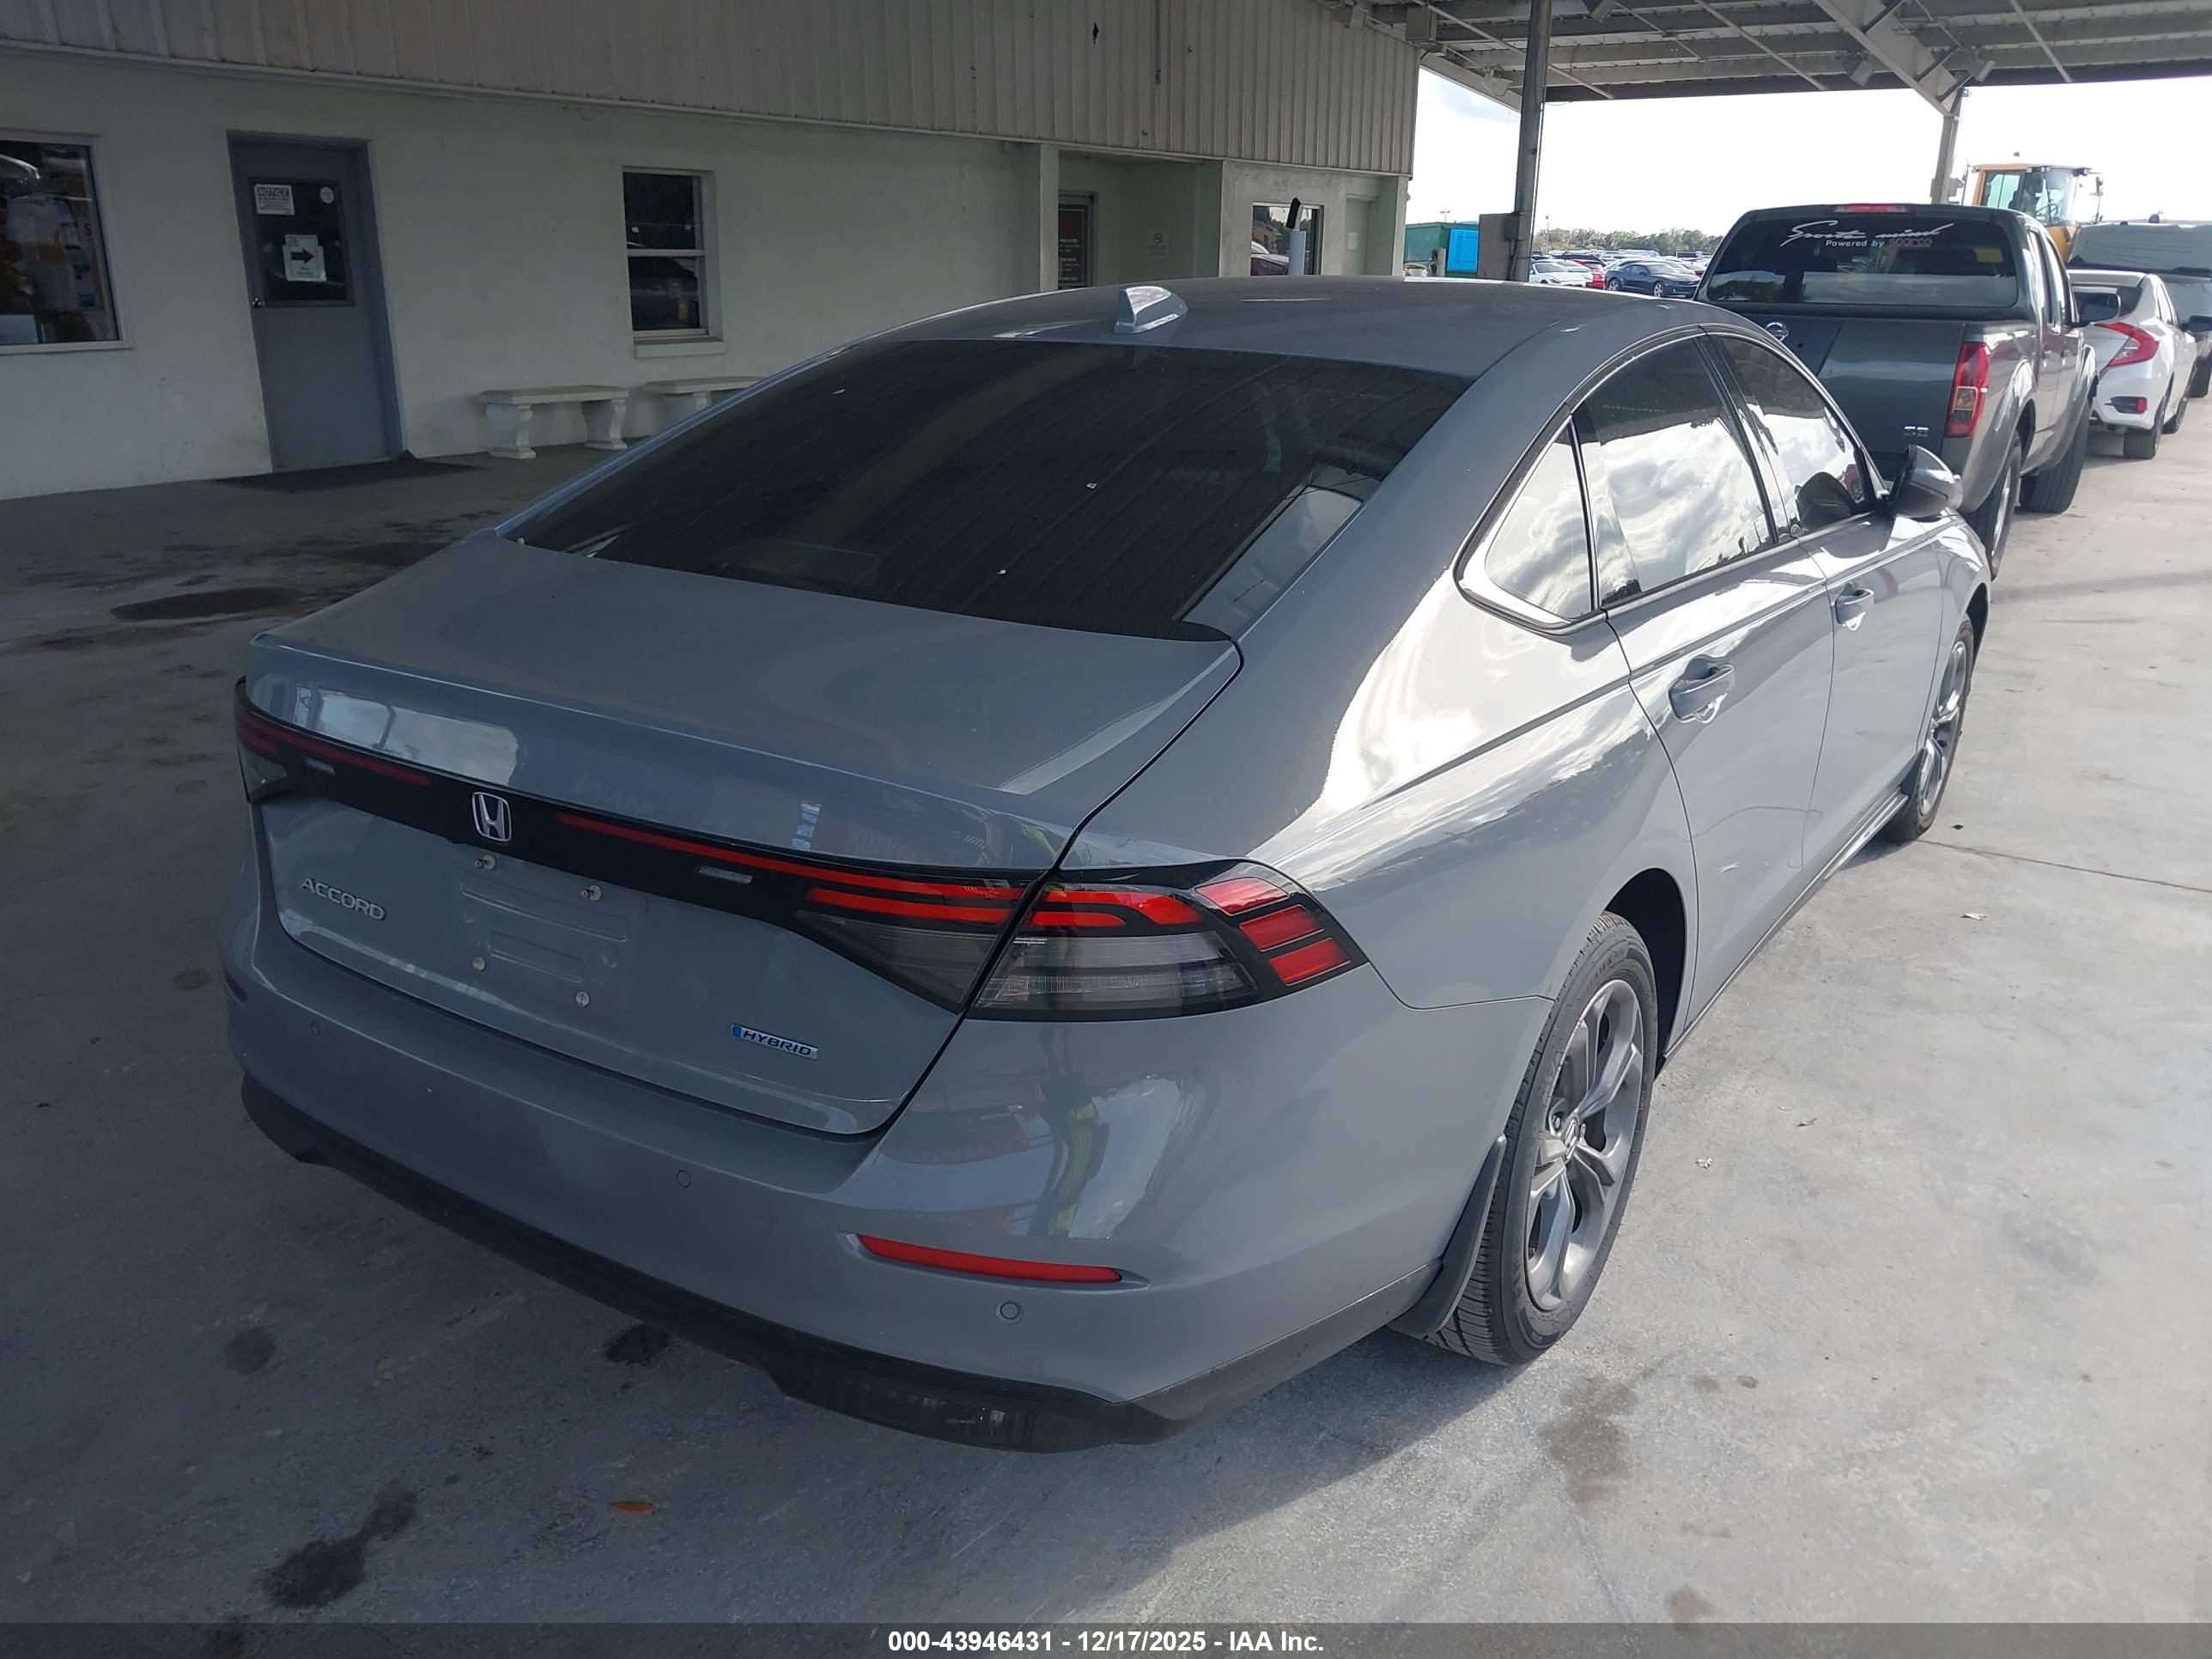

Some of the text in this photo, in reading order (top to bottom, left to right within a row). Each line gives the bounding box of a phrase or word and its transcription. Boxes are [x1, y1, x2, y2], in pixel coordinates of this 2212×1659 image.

[258, 188, 289, 197] NOTICE
[1871, 240, 1885, 248] by
[301, 878, 386, 920] ACCORD
[743, 1030, 811, 1056] HYBRID
